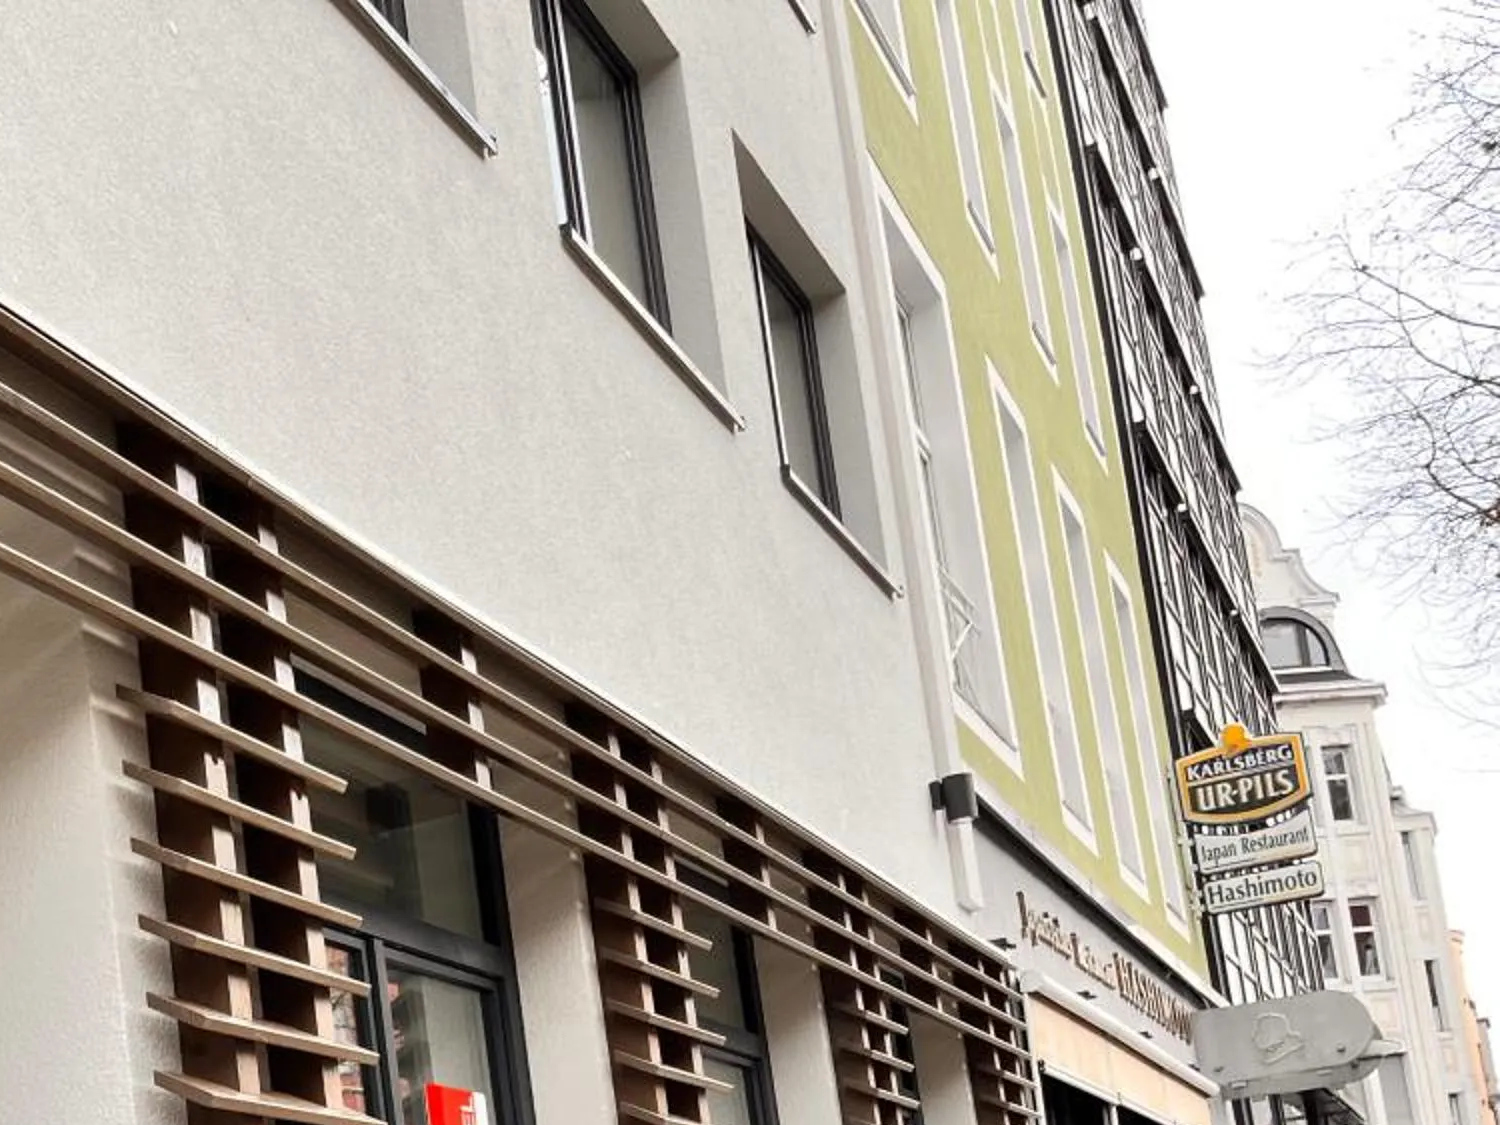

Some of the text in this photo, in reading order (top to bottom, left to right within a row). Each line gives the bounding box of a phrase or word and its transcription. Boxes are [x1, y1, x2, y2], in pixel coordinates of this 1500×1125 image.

[1187, 744, 1293, 781] KARLSBERG
[1195, 769, 1294, 811] UR-PILS
[1201, 826, 1309, 867] Japan Restaurant
[1207, 869, 1318, 905] Hashimoto
